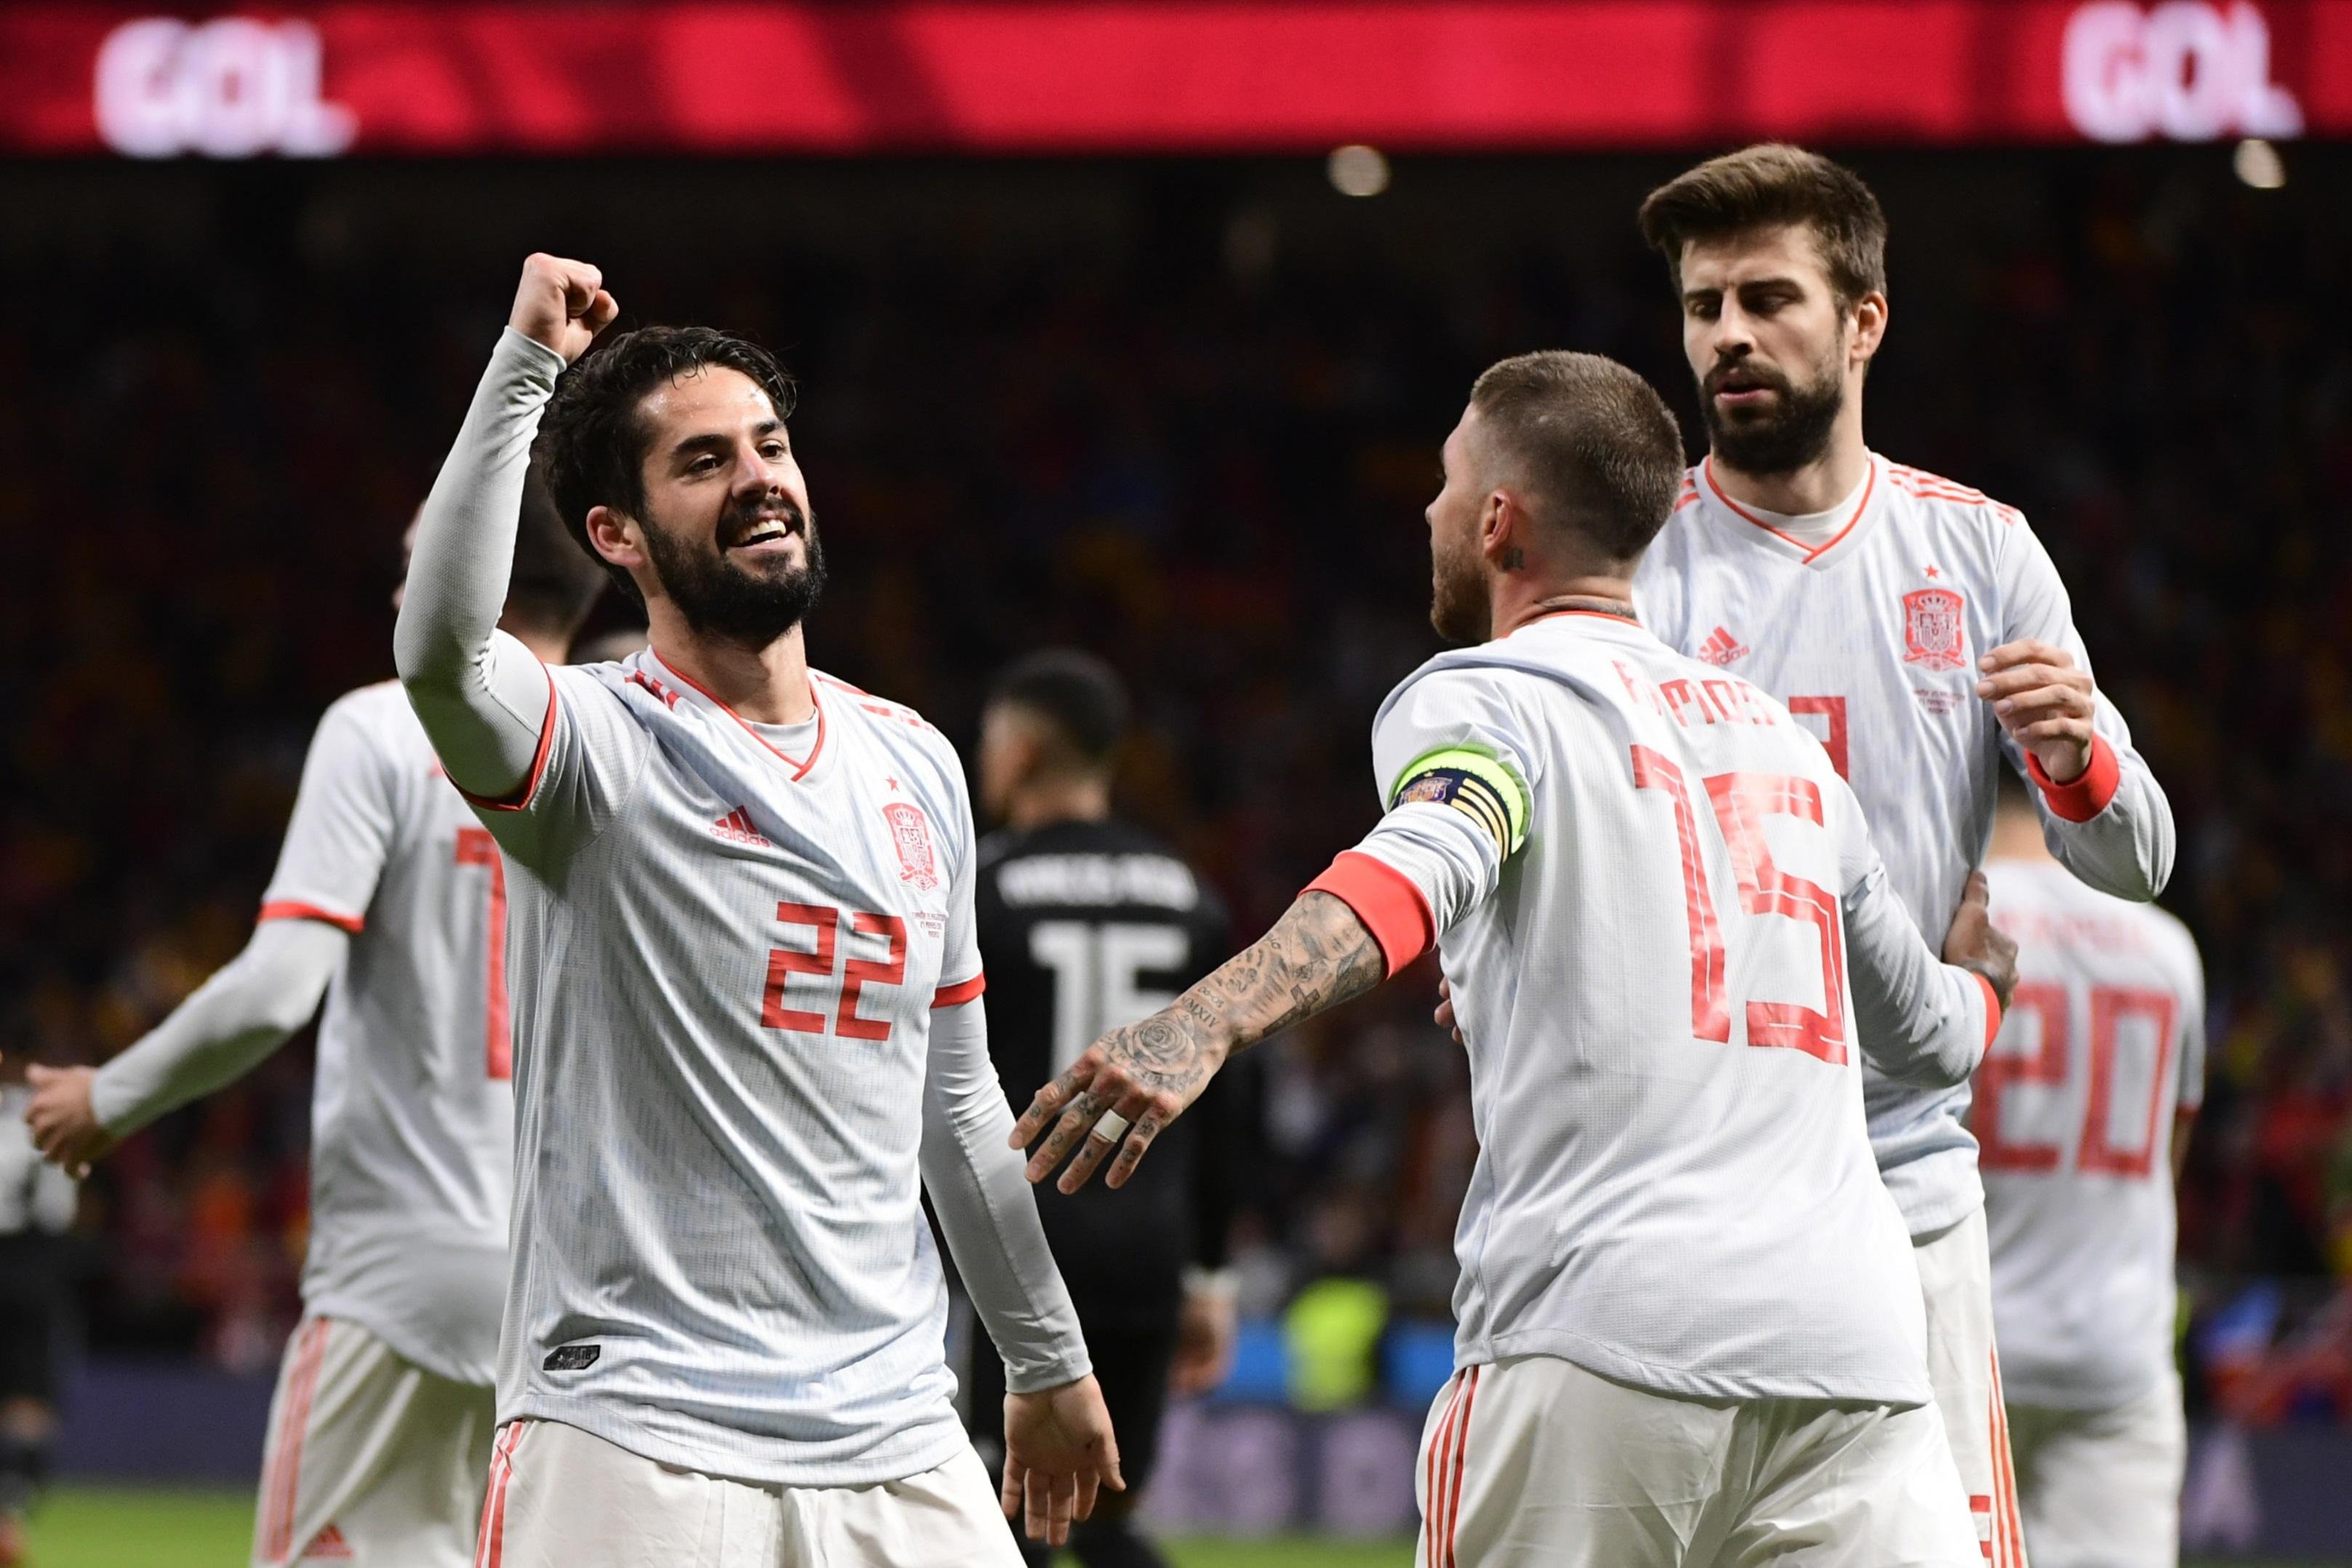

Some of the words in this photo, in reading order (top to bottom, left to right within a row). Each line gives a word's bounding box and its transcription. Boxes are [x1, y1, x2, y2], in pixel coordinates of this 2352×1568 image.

[709, 827, 771, 848] adidas
[1631, 744, 1848, 1066] 15
[760, 901, 907, 1041] 22
[1972, 981, 2178, 1178] 20
